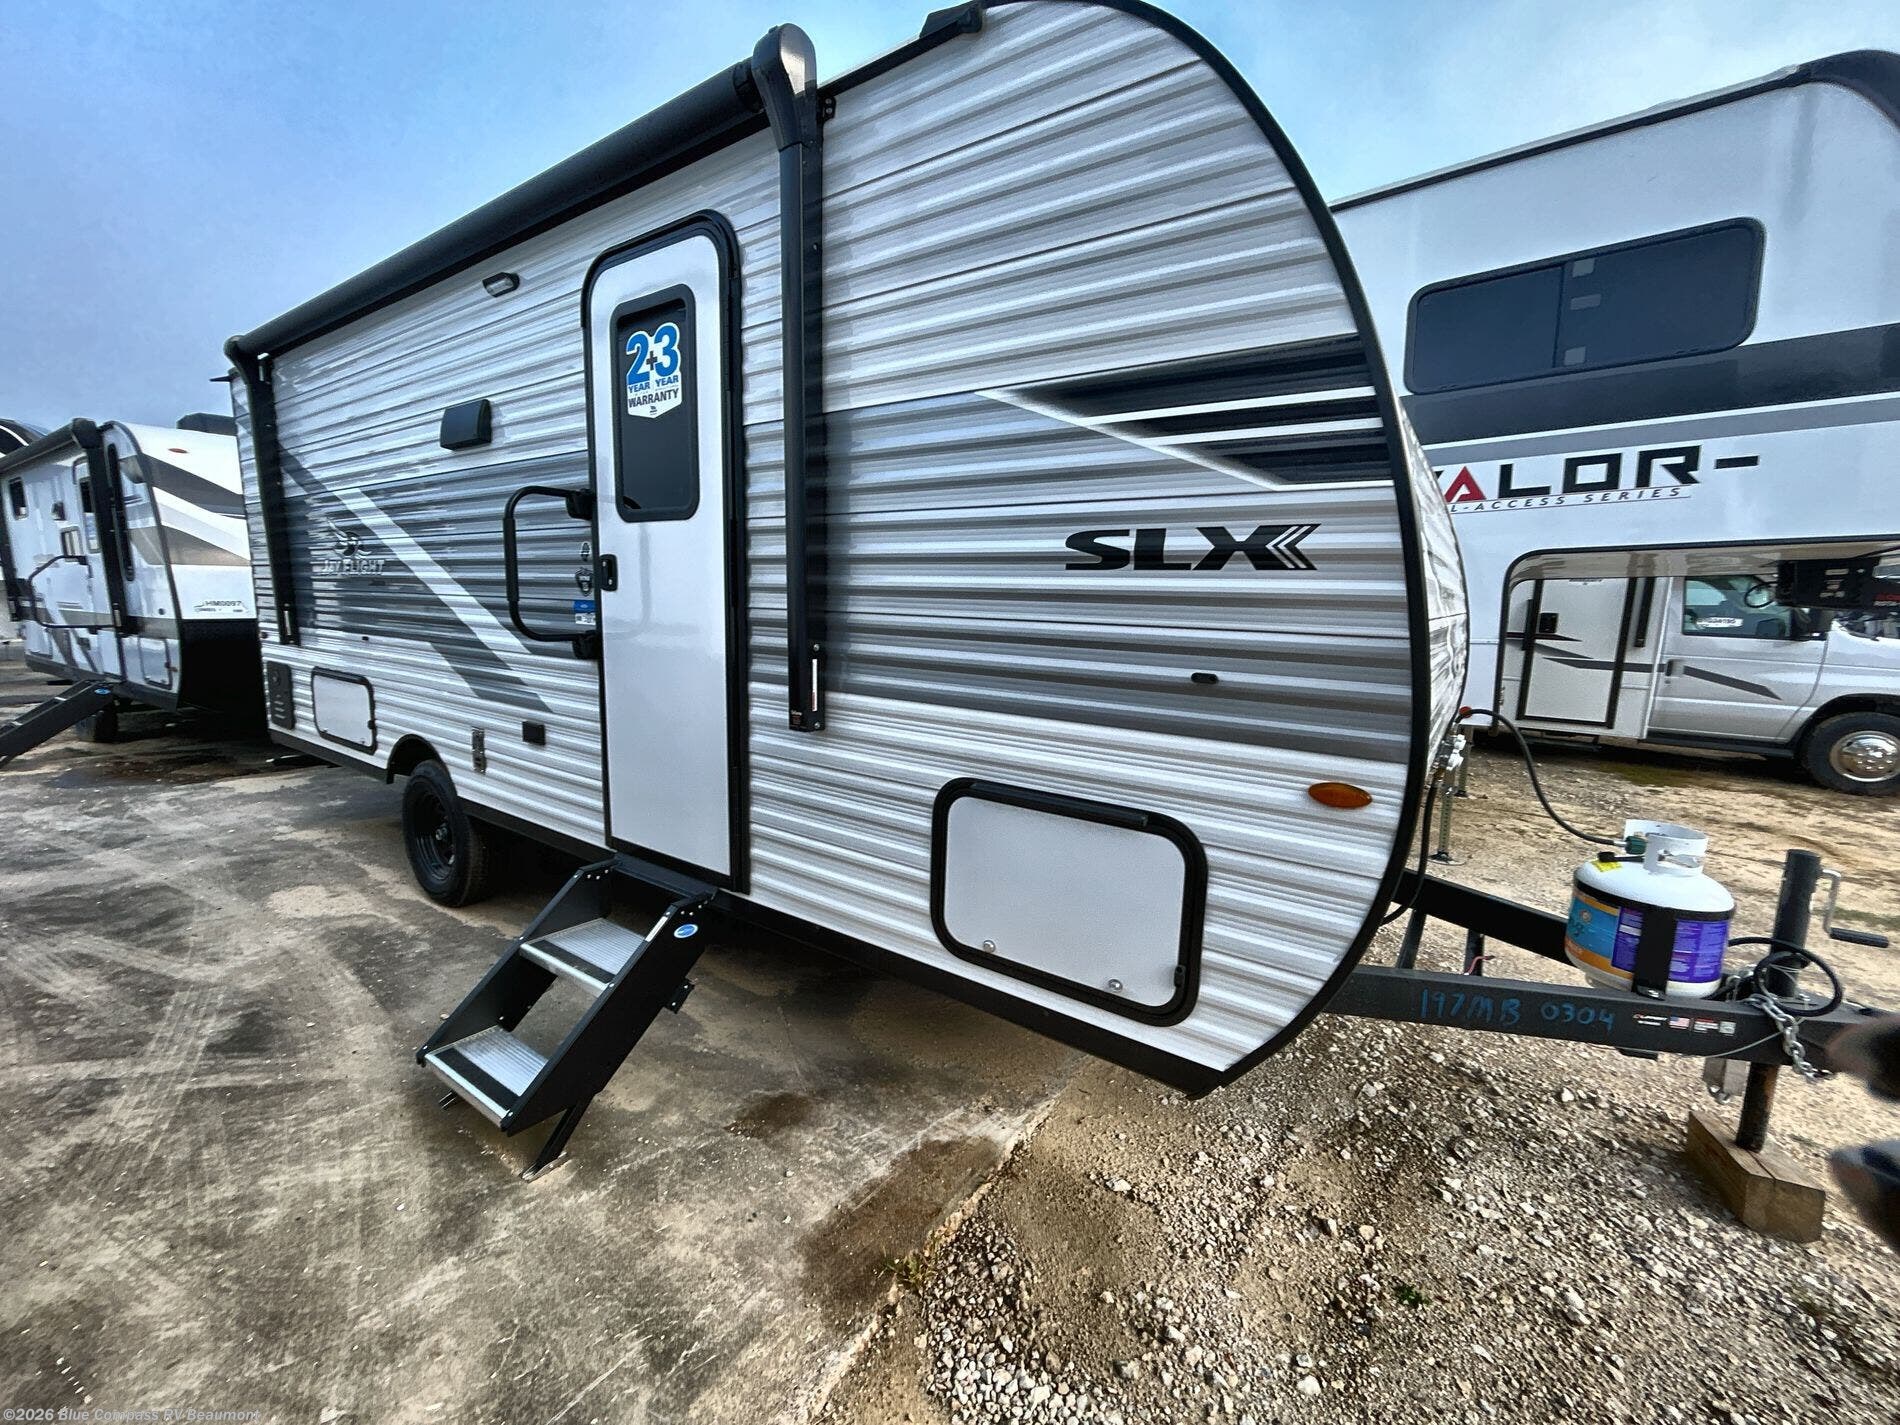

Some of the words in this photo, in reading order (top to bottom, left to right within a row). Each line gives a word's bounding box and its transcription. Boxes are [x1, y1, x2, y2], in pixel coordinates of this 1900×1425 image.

[628, 381, 650, 394] YEAR
[655, 375, 679, 387] YEAR
[628, 388, 680, 408] WARRANTY
[1433, 444, 1702, 503] ALOR
[1584, 486, 1681, 504] SERIES
[1065, 523, 1321, 571] SLX
[1539, 1001, 1616, 1033] 0304
